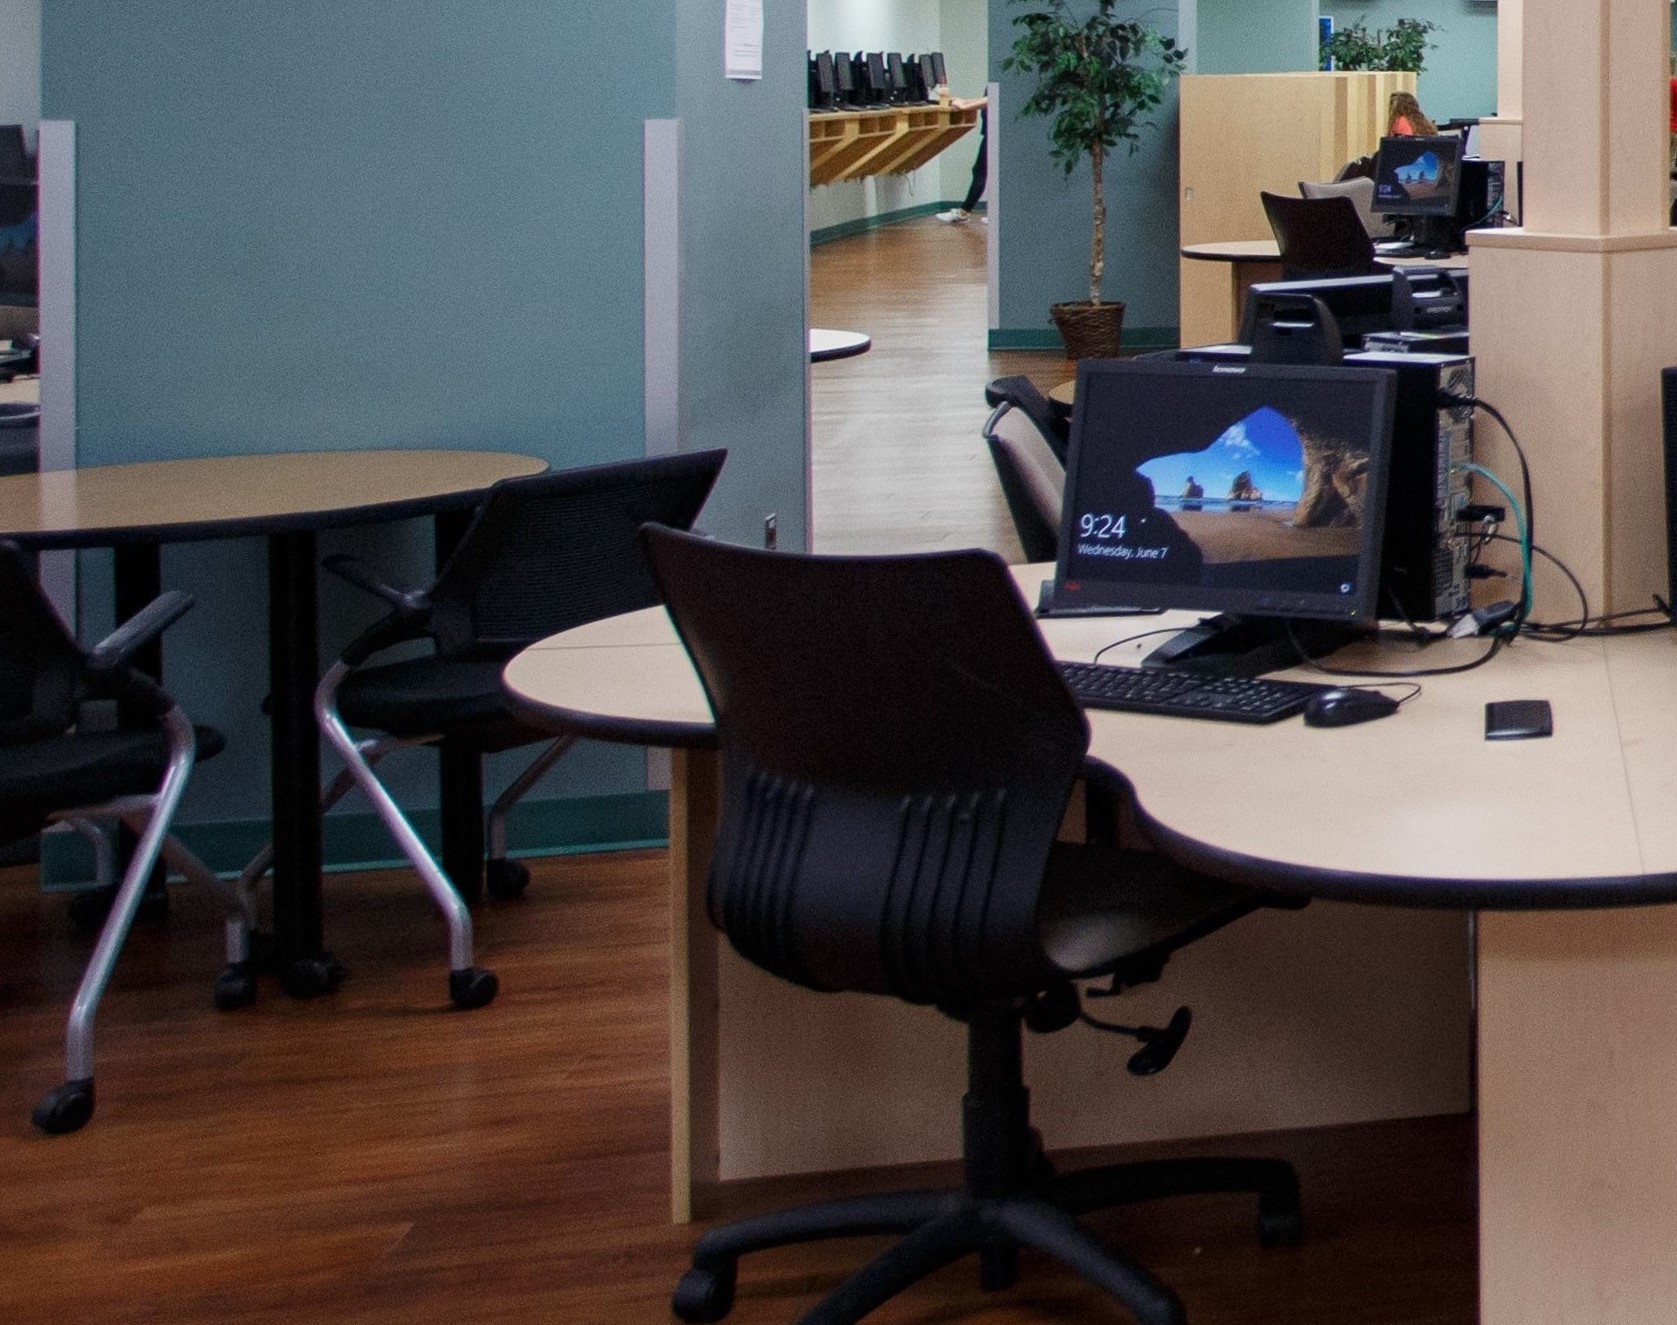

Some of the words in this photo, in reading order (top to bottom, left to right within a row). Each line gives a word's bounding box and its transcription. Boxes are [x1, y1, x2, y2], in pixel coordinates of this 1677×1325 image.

[1080, 513, 1126, 538] 9:24
[1078, 544, 1133, 559] Wednesday,
[1135, 547, 1158, 559] June
[1160, 547, 1169, 559] 7
